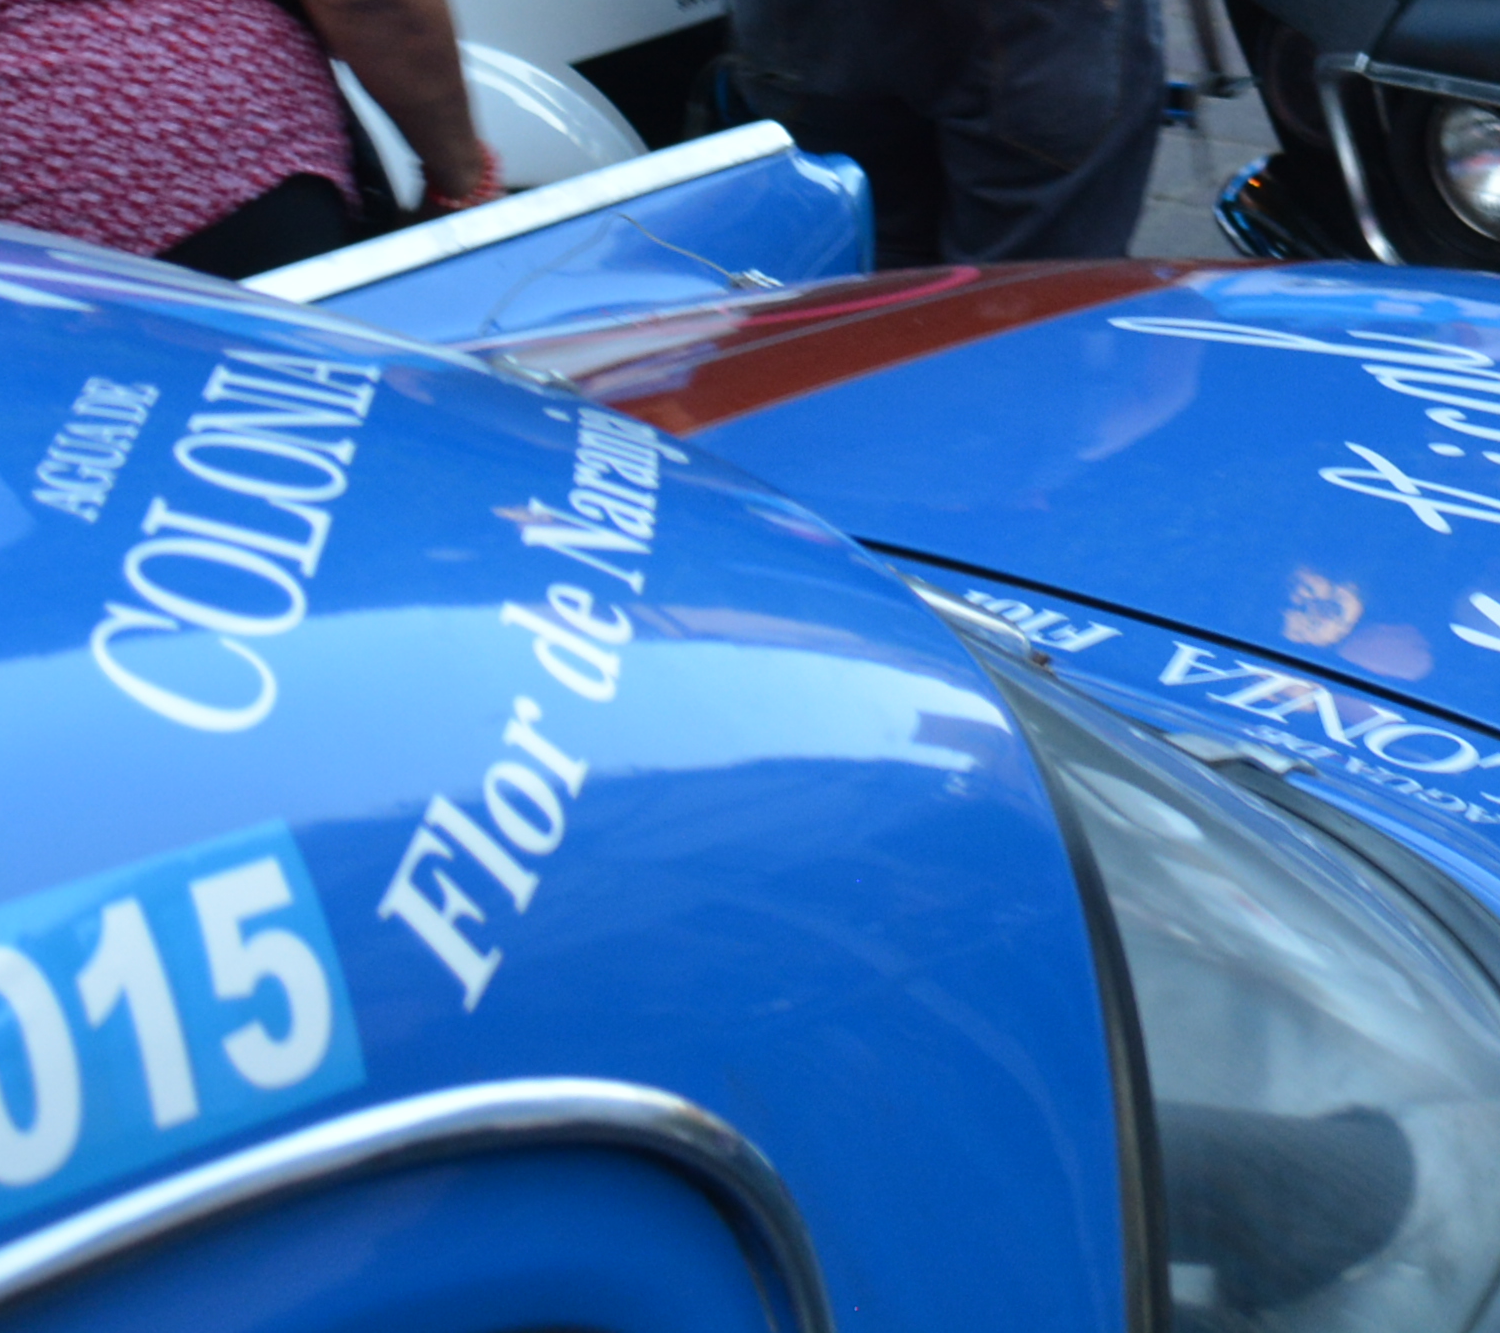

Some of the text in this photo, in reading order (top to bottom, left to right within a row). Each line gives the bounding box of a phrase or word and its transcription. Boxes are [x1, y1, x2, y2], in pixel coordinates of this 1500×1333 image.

[31, 418, 141, 524] AGUA
[90, 347, 382, 735] COLONIA
[373, 693, 592, 1014] Flor
[499, 582, 634, 704] de
